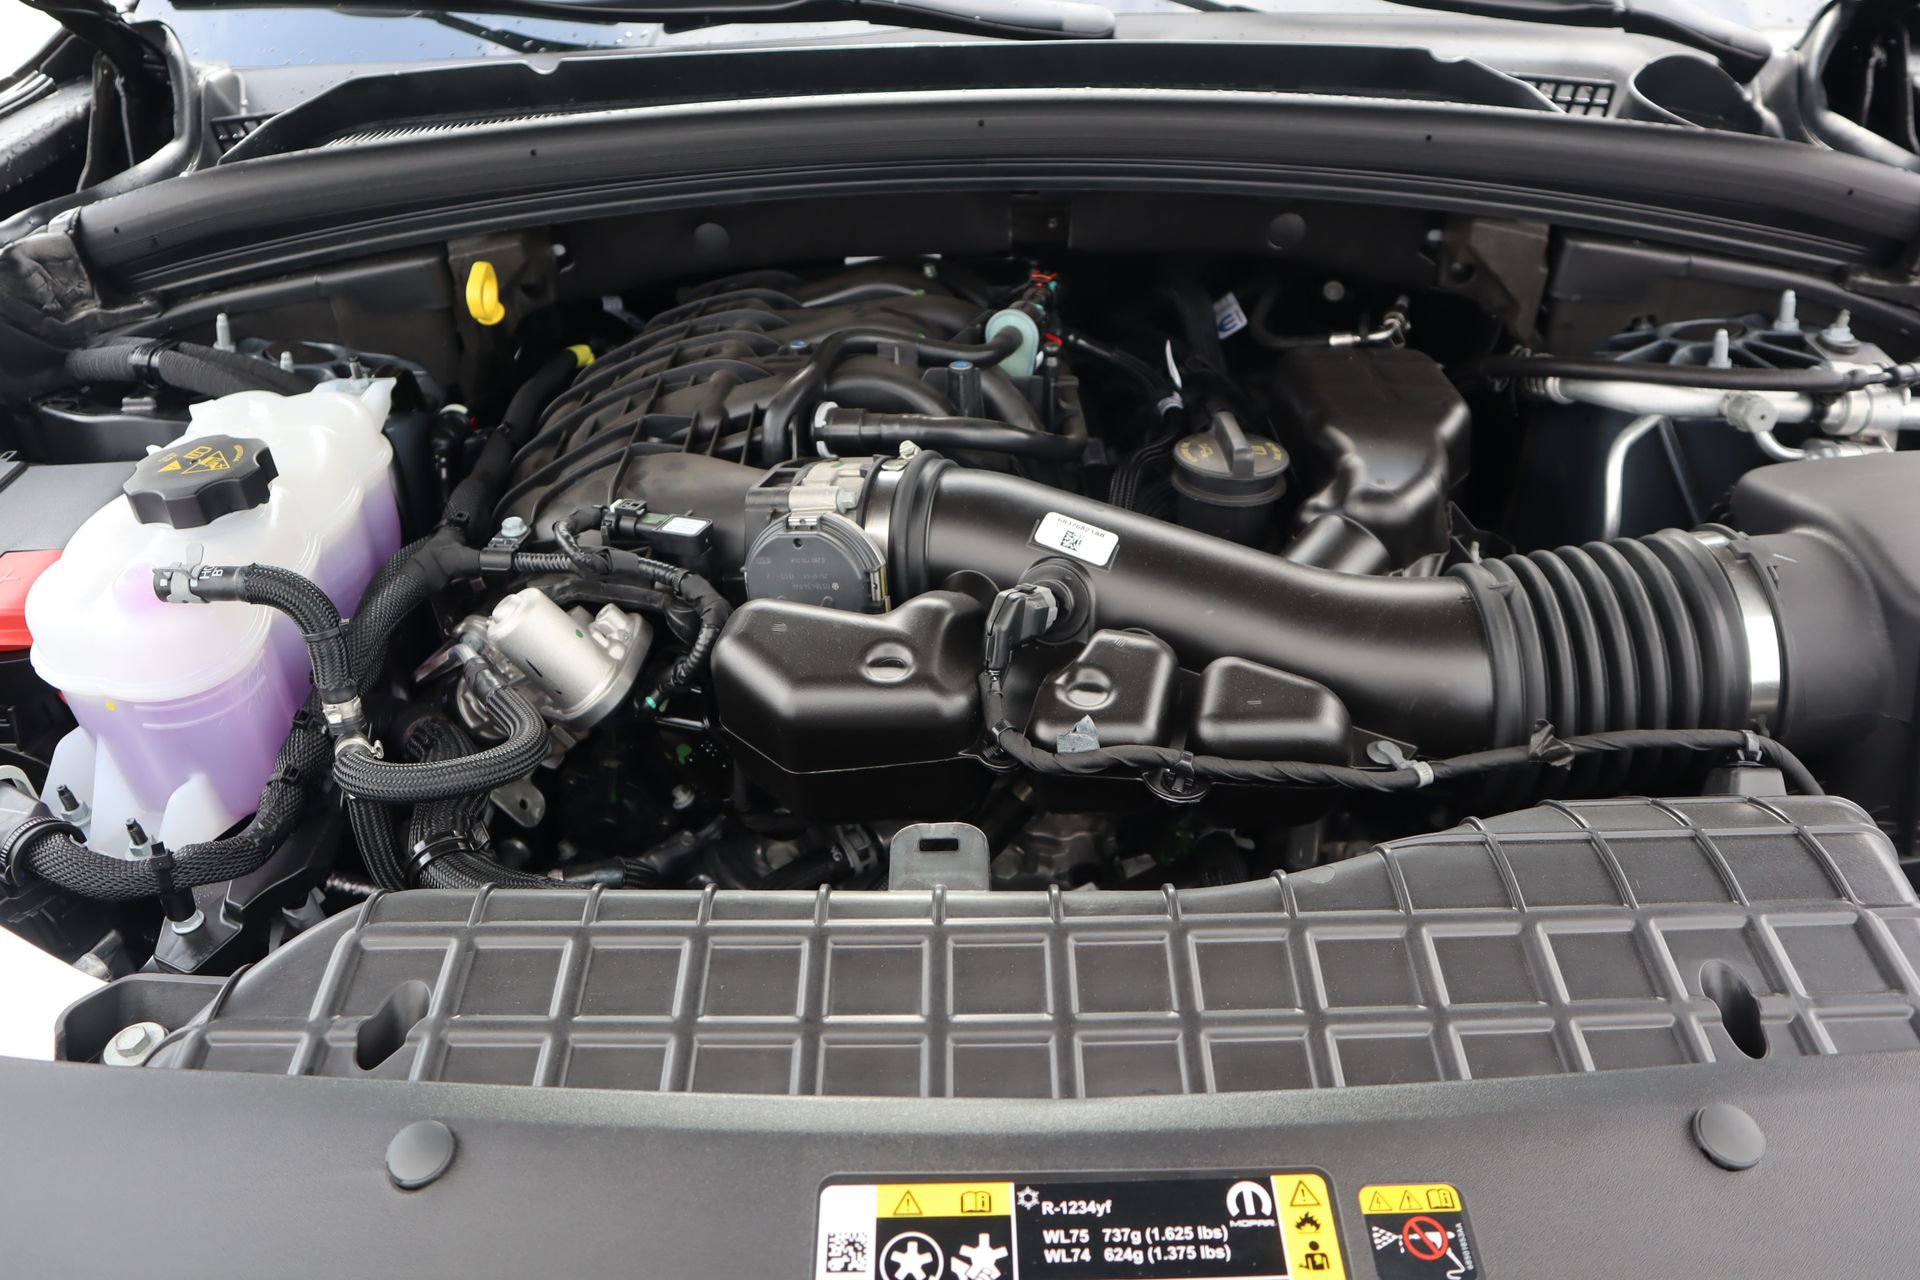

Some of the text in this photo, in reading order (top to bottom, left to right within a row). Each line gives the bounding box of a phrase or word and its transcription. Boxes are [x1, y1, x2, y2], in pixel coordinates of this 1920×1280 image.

[1041, 1199, 1112, 1217] R-1234yf
[1042, 1224, 1228, 1245] WL75 737g (1.625 lbs)
[1043, 1244, 1231, 1265] WL74 624g (1.375 lbs)
